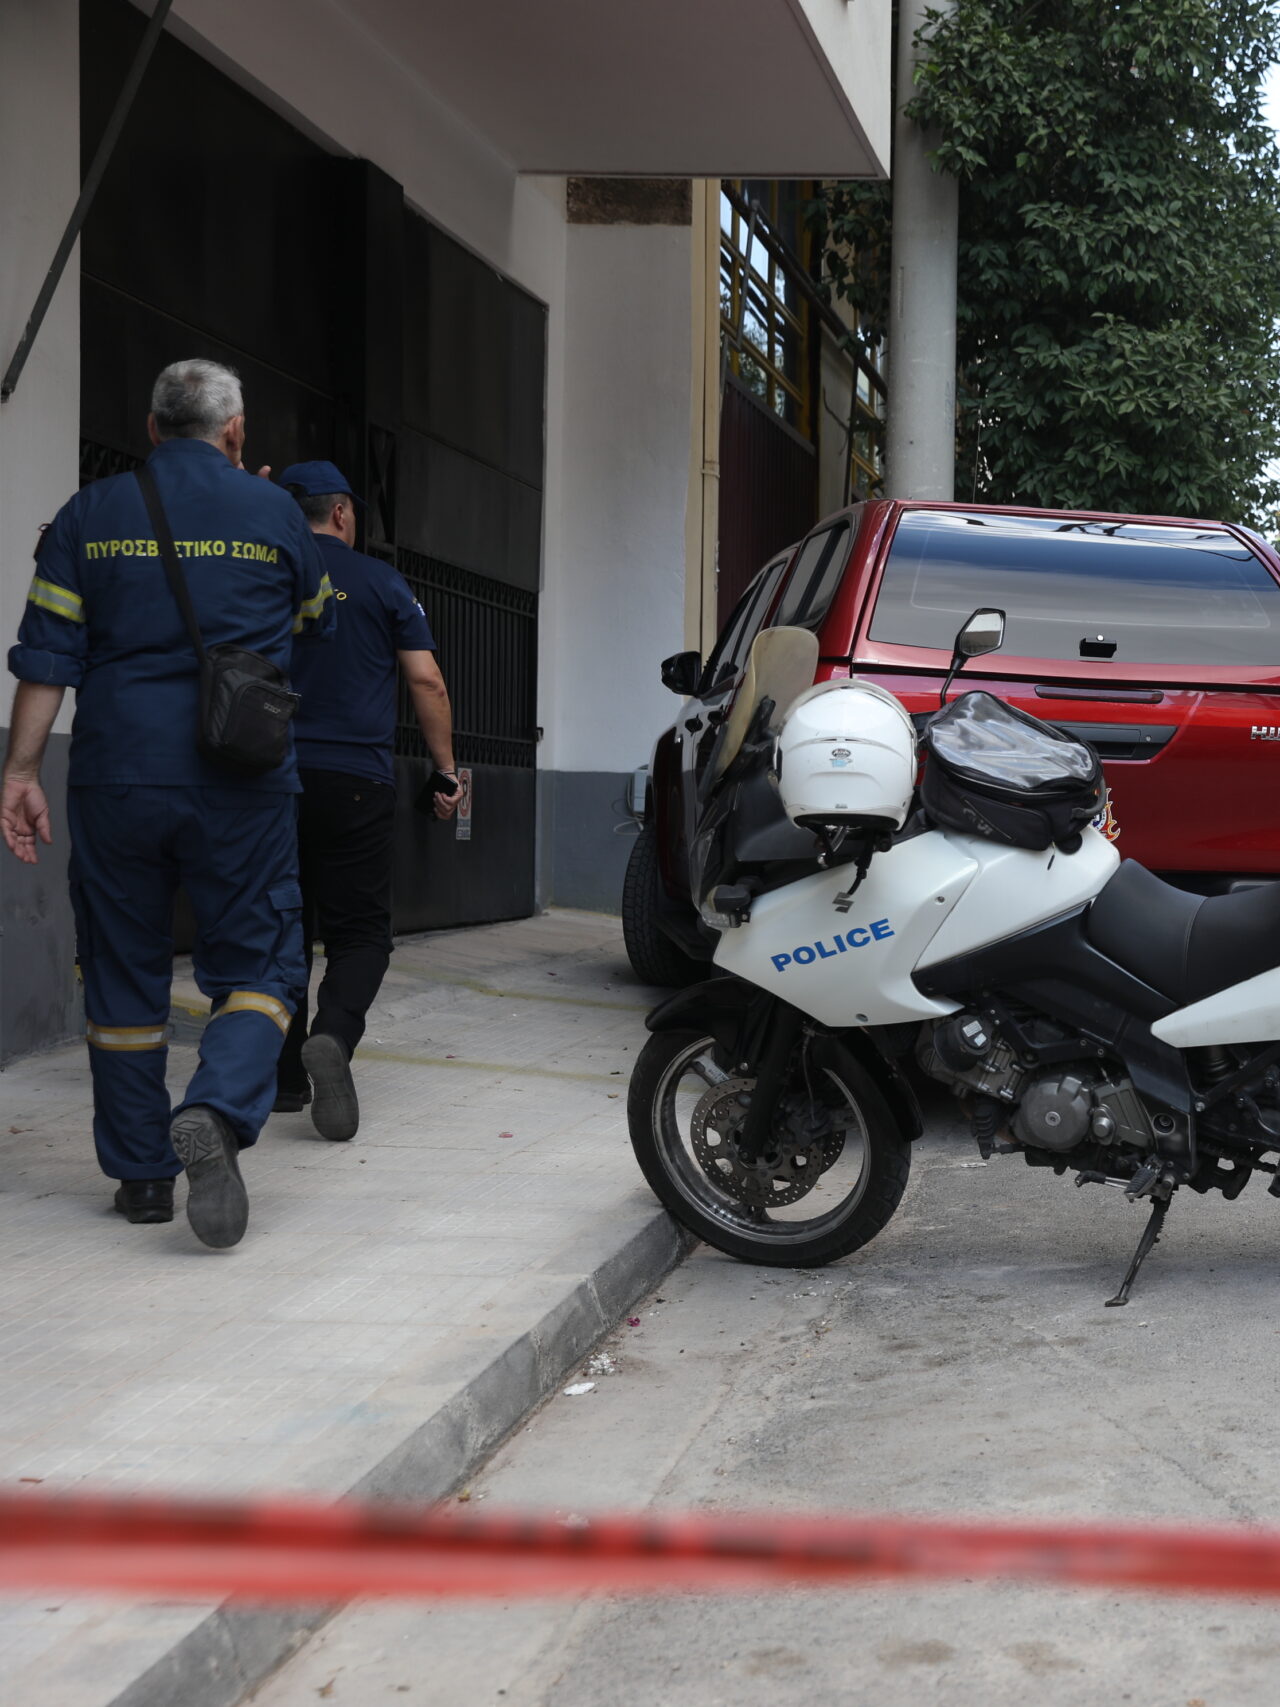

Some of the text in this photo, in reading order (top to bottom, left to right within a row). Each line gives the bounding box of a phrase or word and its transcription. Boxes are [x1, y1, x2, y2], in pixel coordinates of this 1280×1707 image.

[86, 540, 278, 564] ΠΥΡΟΣΒΣΤΙΚΟ ΣΩΜΑ
[770, 918, 895, 972] POLICE
